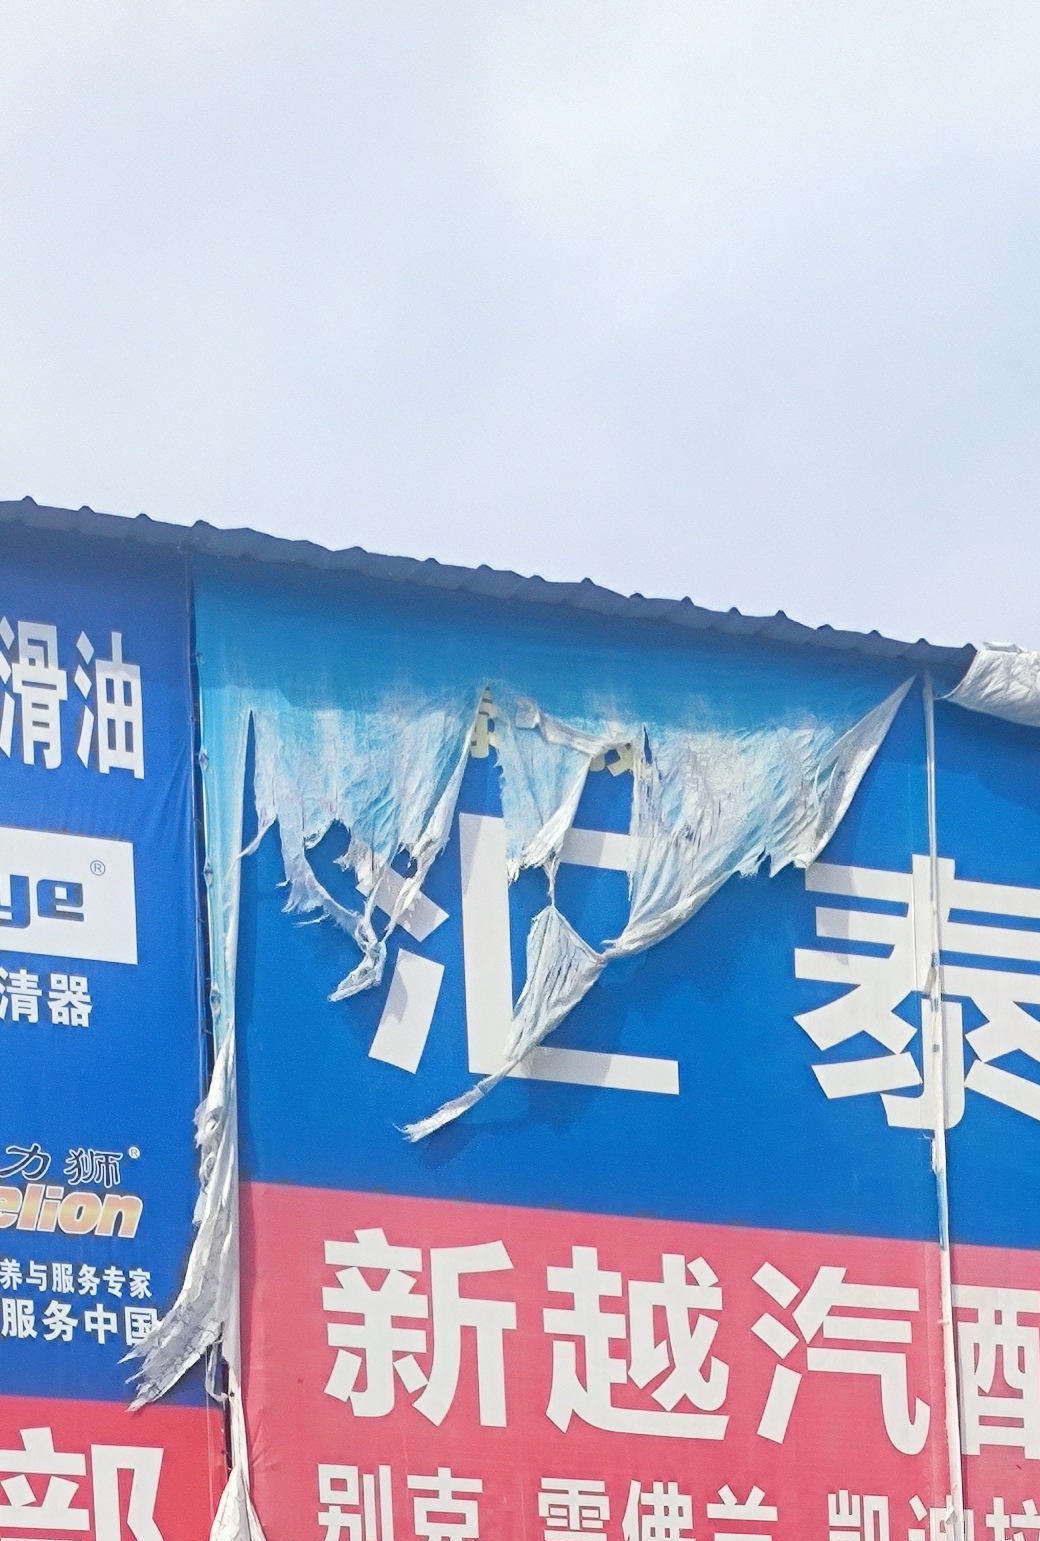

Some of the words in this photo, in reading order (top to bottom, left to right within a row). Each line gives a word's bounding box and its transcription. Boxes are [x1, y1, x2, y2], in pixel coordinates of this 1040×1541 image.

[0, 616, 146, 781] 滑油
[0, 1257, 153, 1299] 养与服务专家
